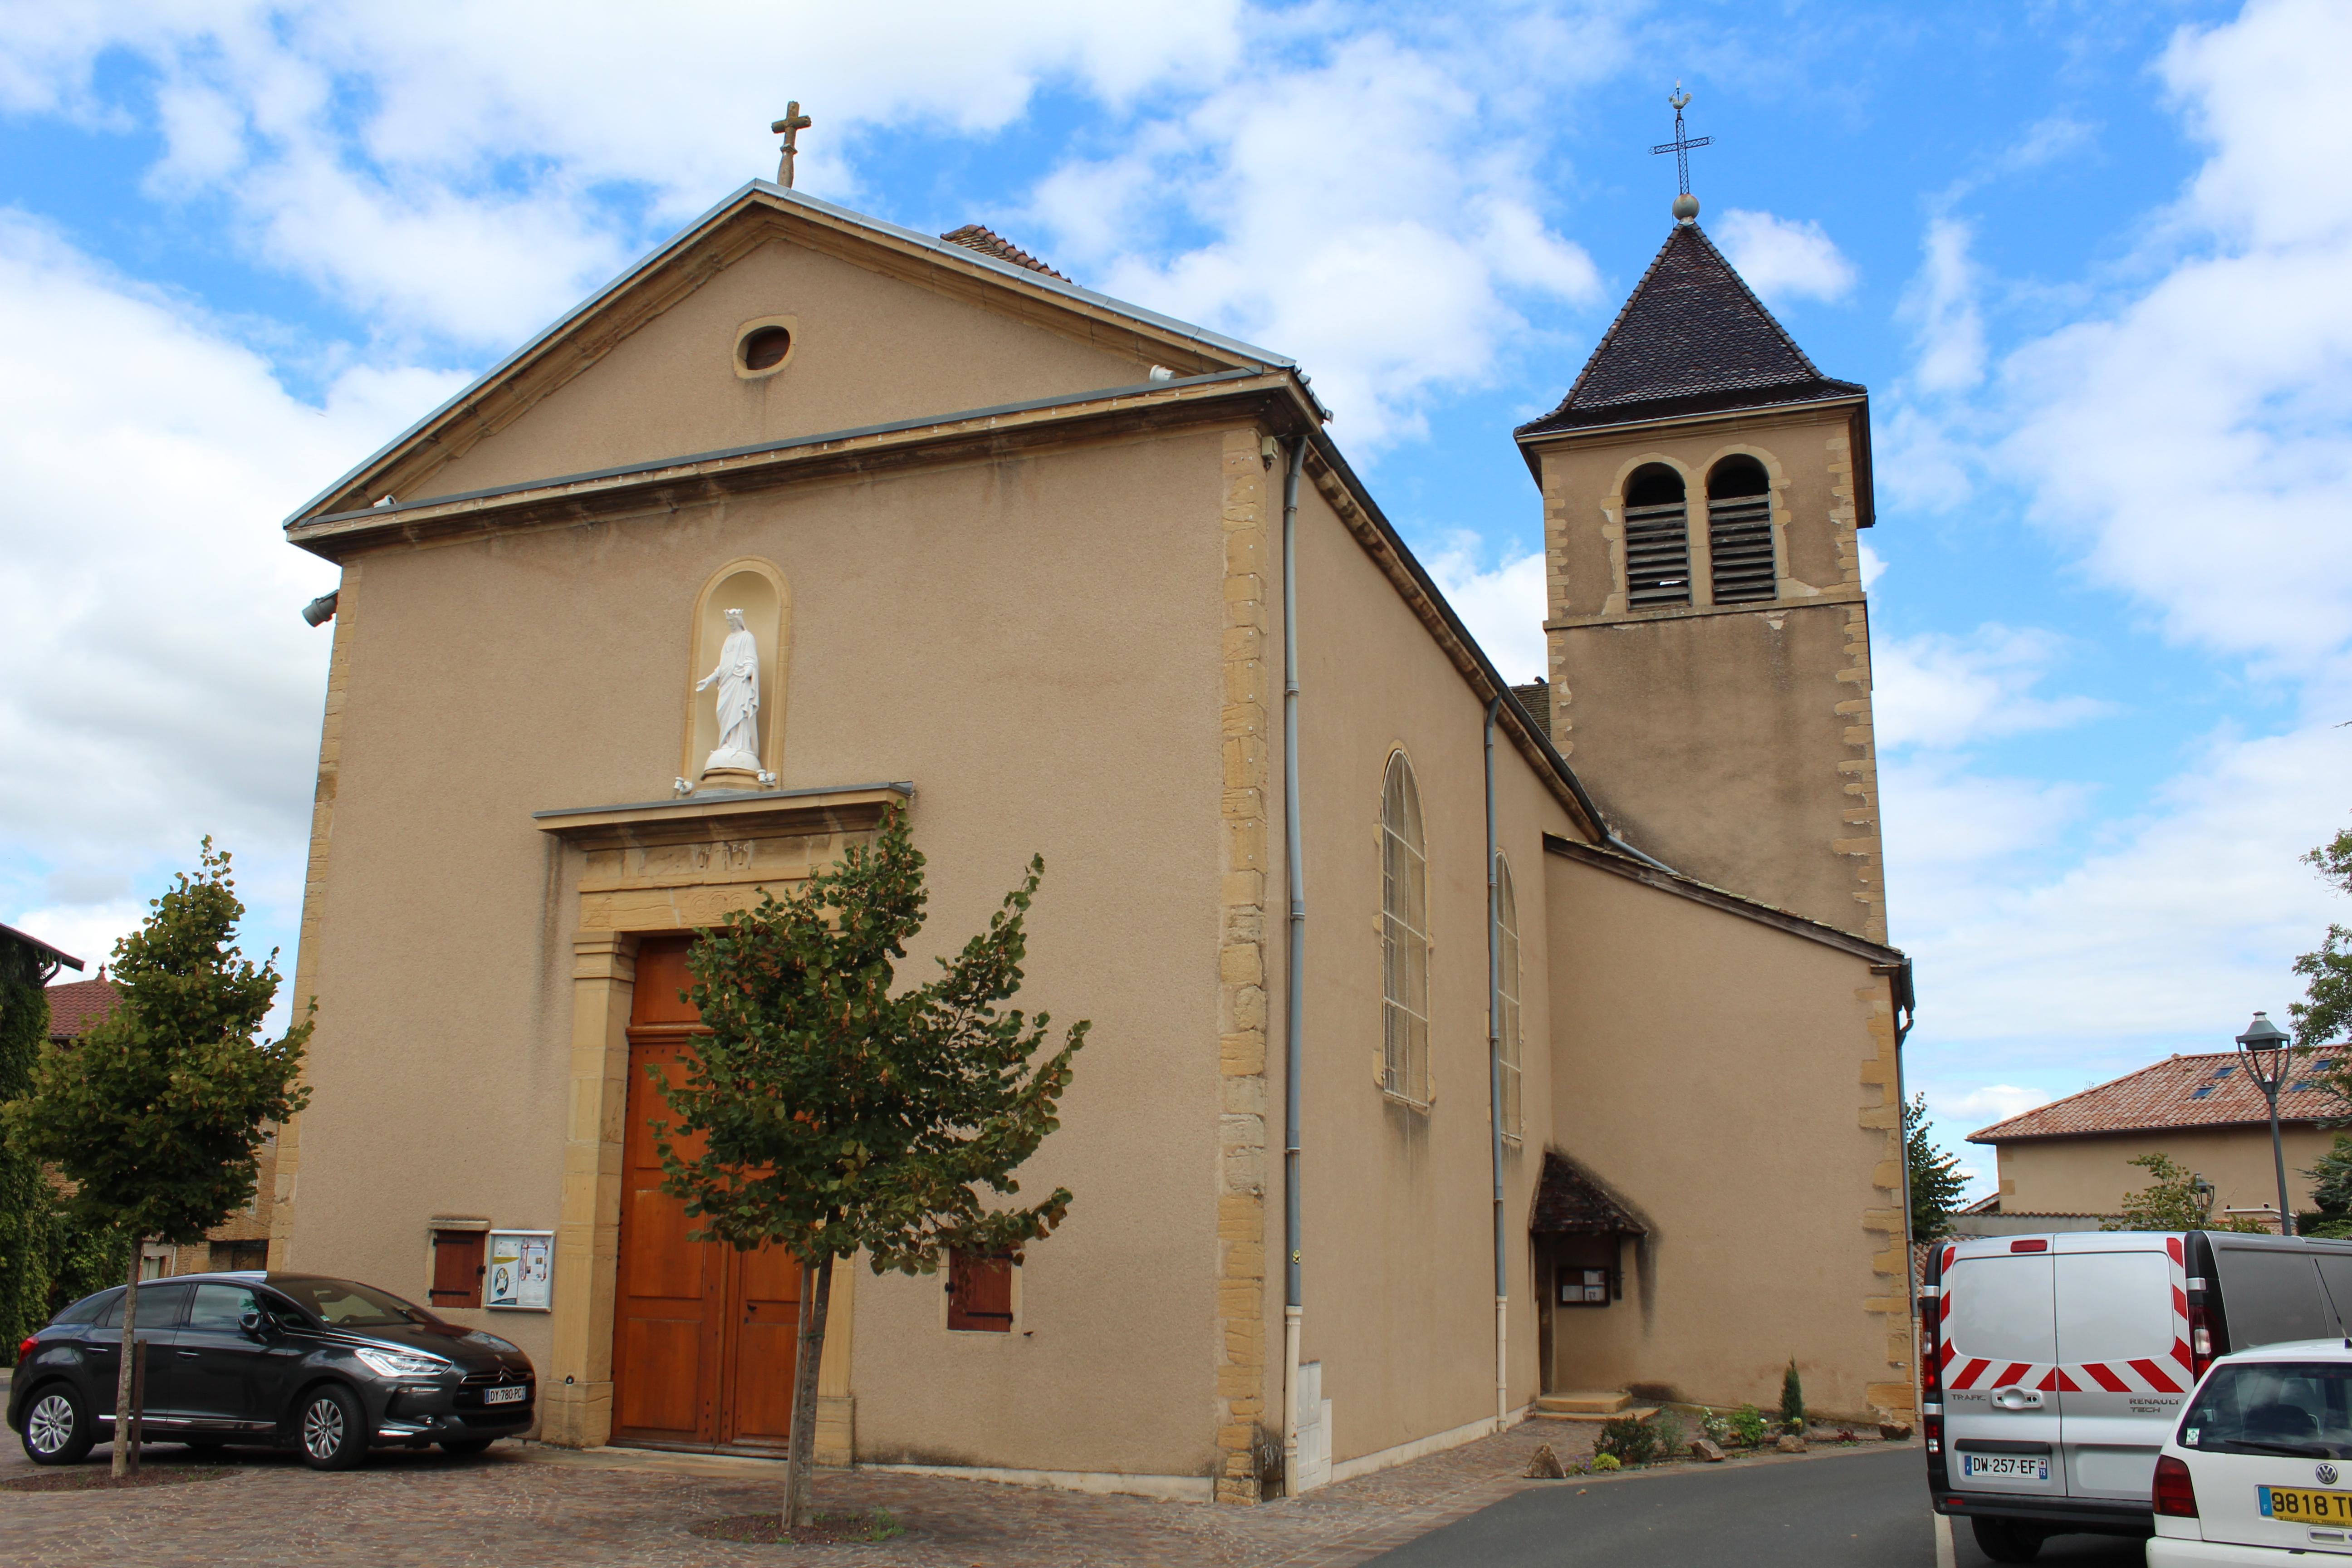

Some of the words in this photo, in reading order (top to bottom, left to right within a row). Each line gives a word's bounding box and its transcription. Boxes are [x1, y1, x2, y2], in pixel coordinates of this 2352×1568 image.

[490, 1388, 522, 1401] DY-780-PC
[1974, 1457, 2036, 1474] DW-257-EF
[2271, 1492, 2328, 1516] 9818
[2332, 1496, 2352, 1518] T
